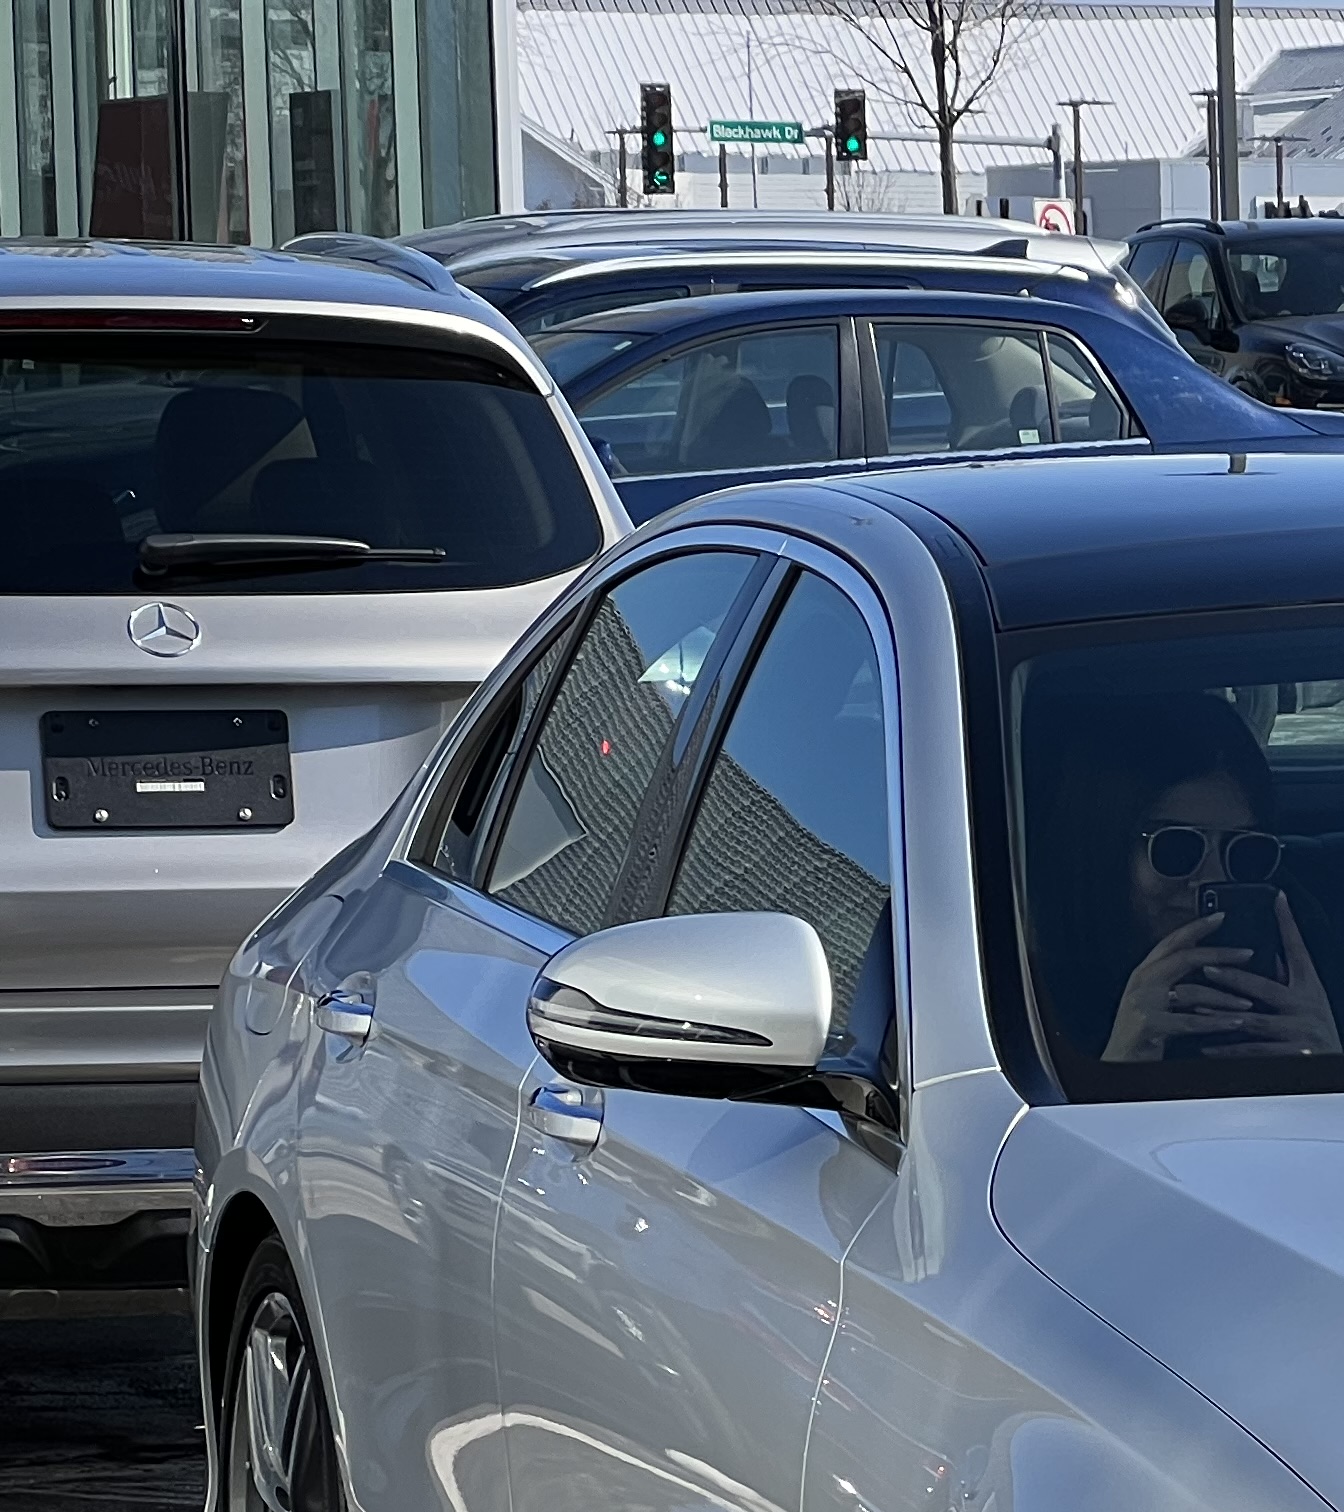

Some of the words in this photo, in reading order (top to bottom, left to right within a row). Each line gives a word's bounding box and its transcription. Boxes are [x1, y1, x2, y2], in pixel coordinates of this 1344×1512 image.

[712, 123, 782, 139] Blackhawk
[784, 126, 799, 139] Dr
[87, 755, 254, 778] Mercedes-Benz
